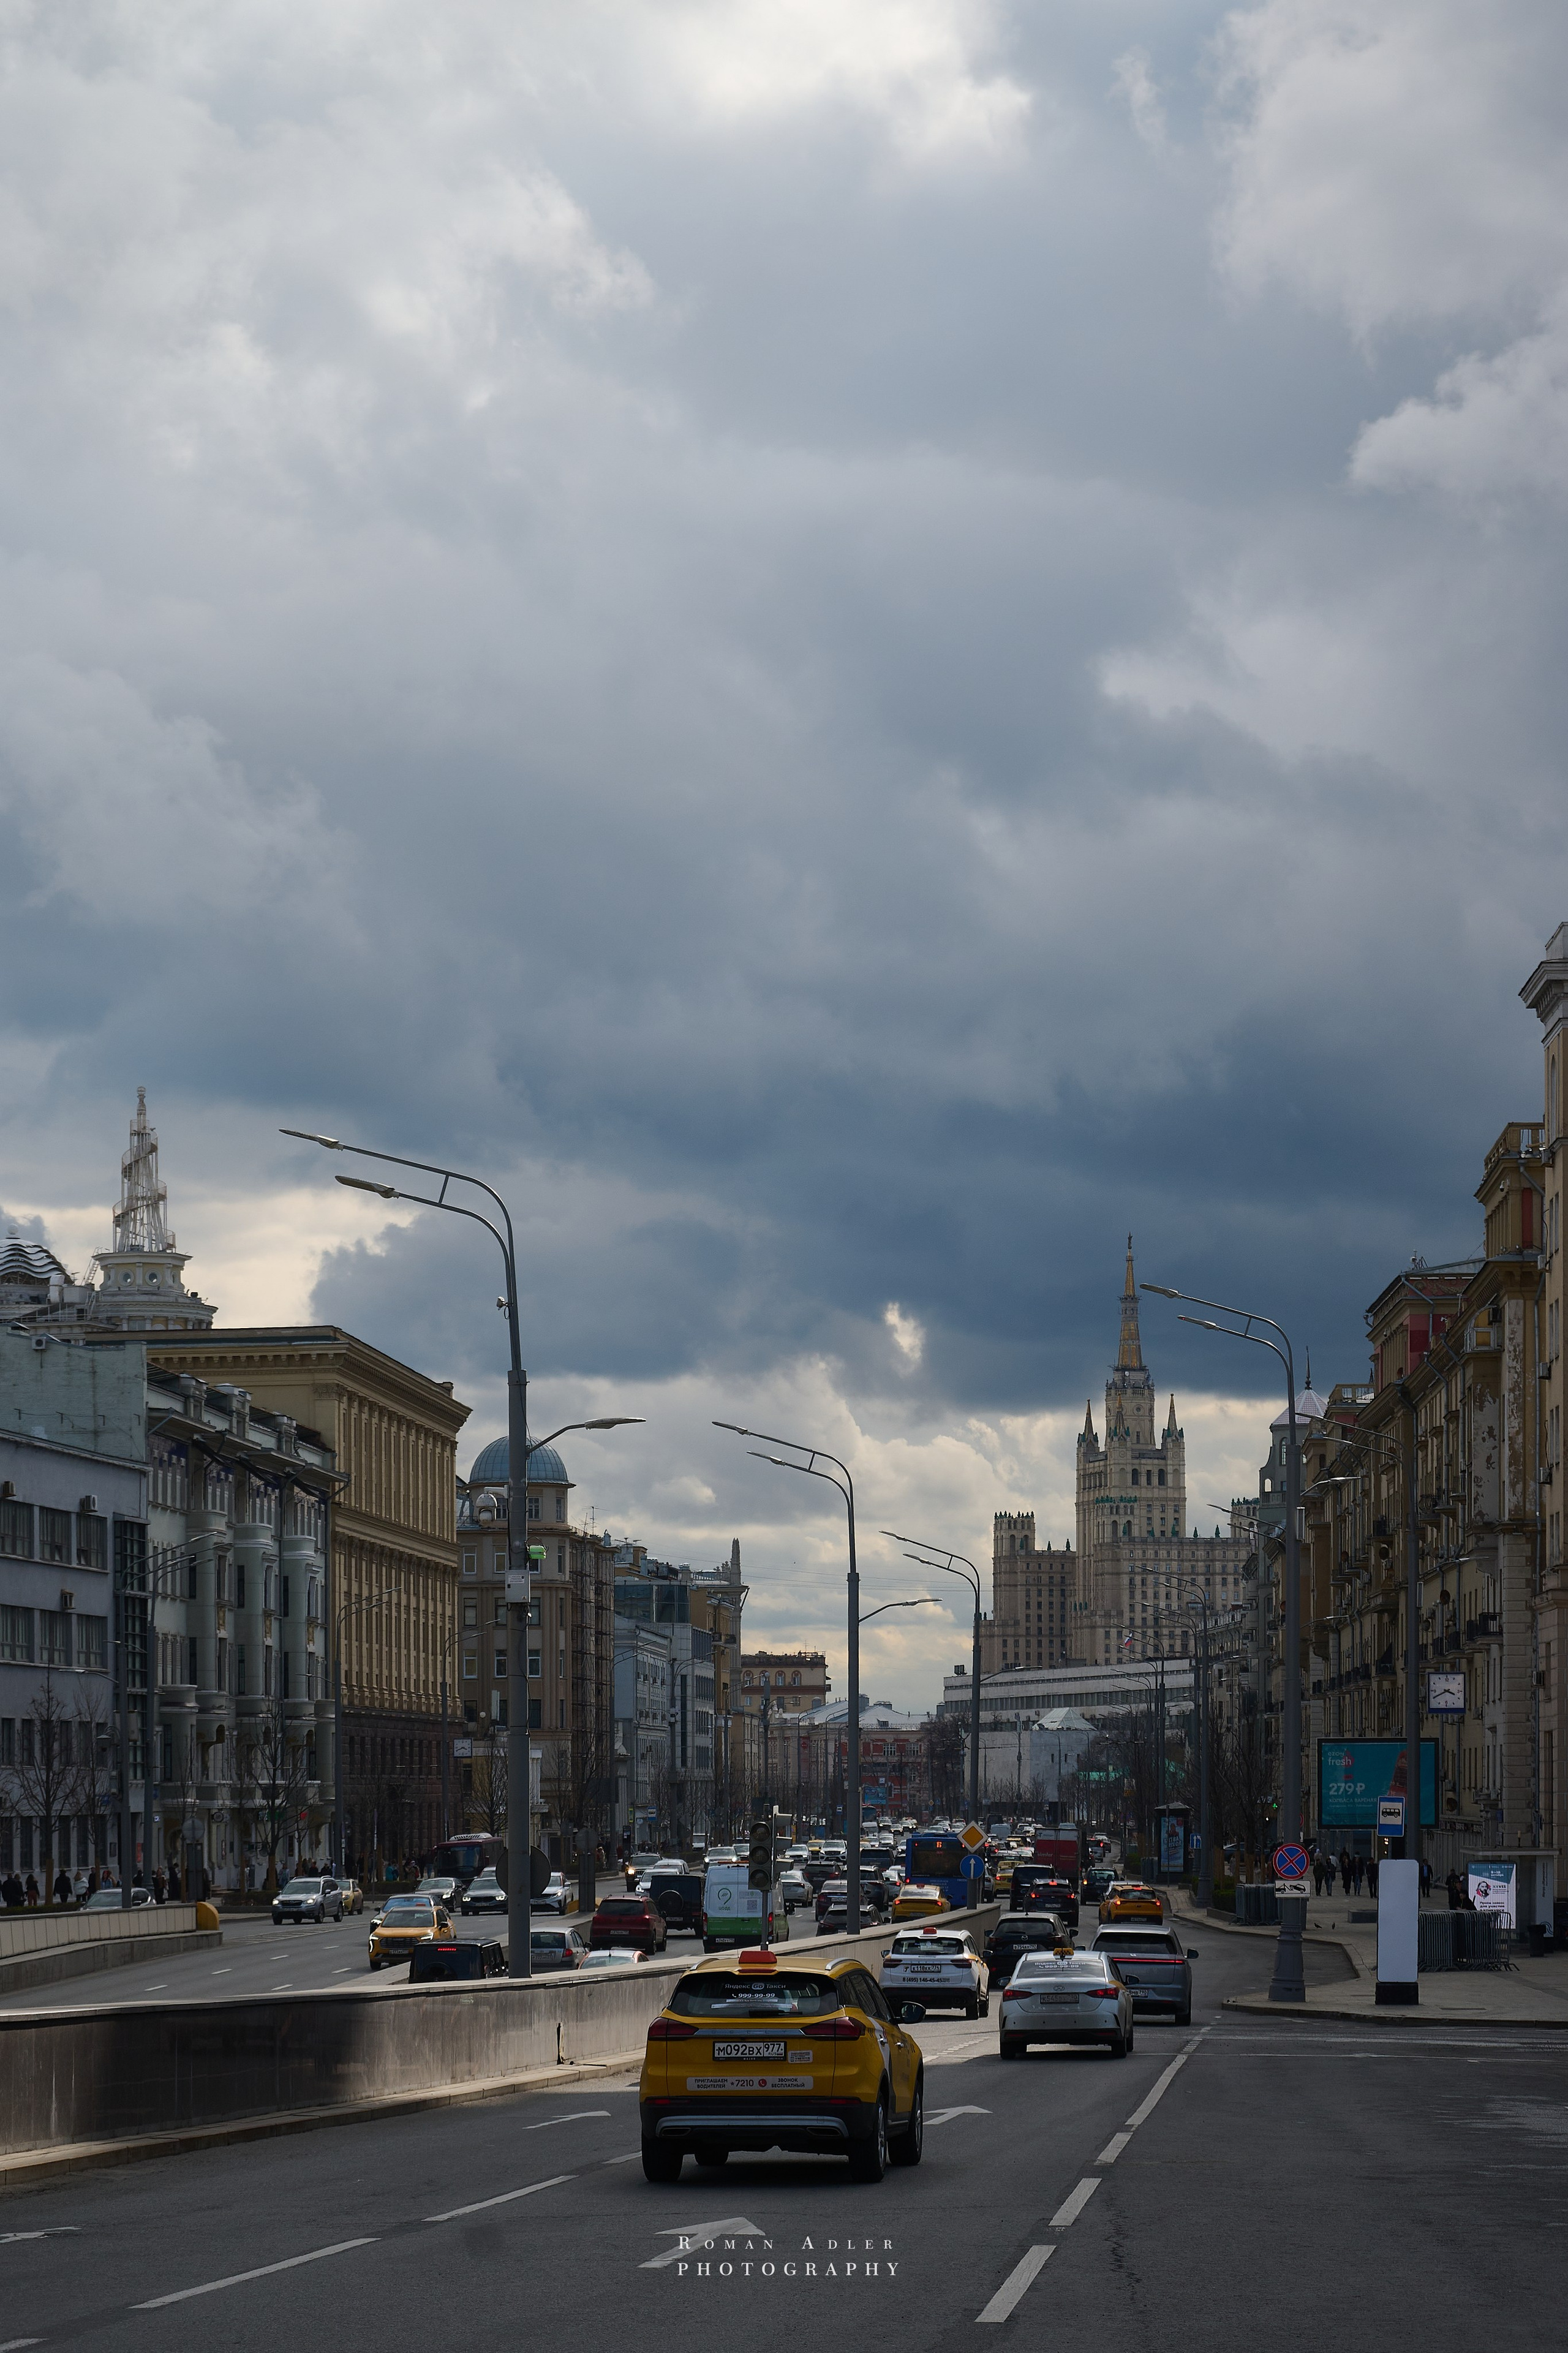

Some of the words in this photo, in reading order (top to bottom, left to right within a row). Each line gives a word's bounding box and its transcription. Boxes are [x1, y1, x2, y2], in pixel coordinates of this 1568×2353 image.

[1328, 1756, 1352, 1766] fresh
[717, 2044, 763, 2057] М092ВХ
[764, 2043, 781, 2052] 977
